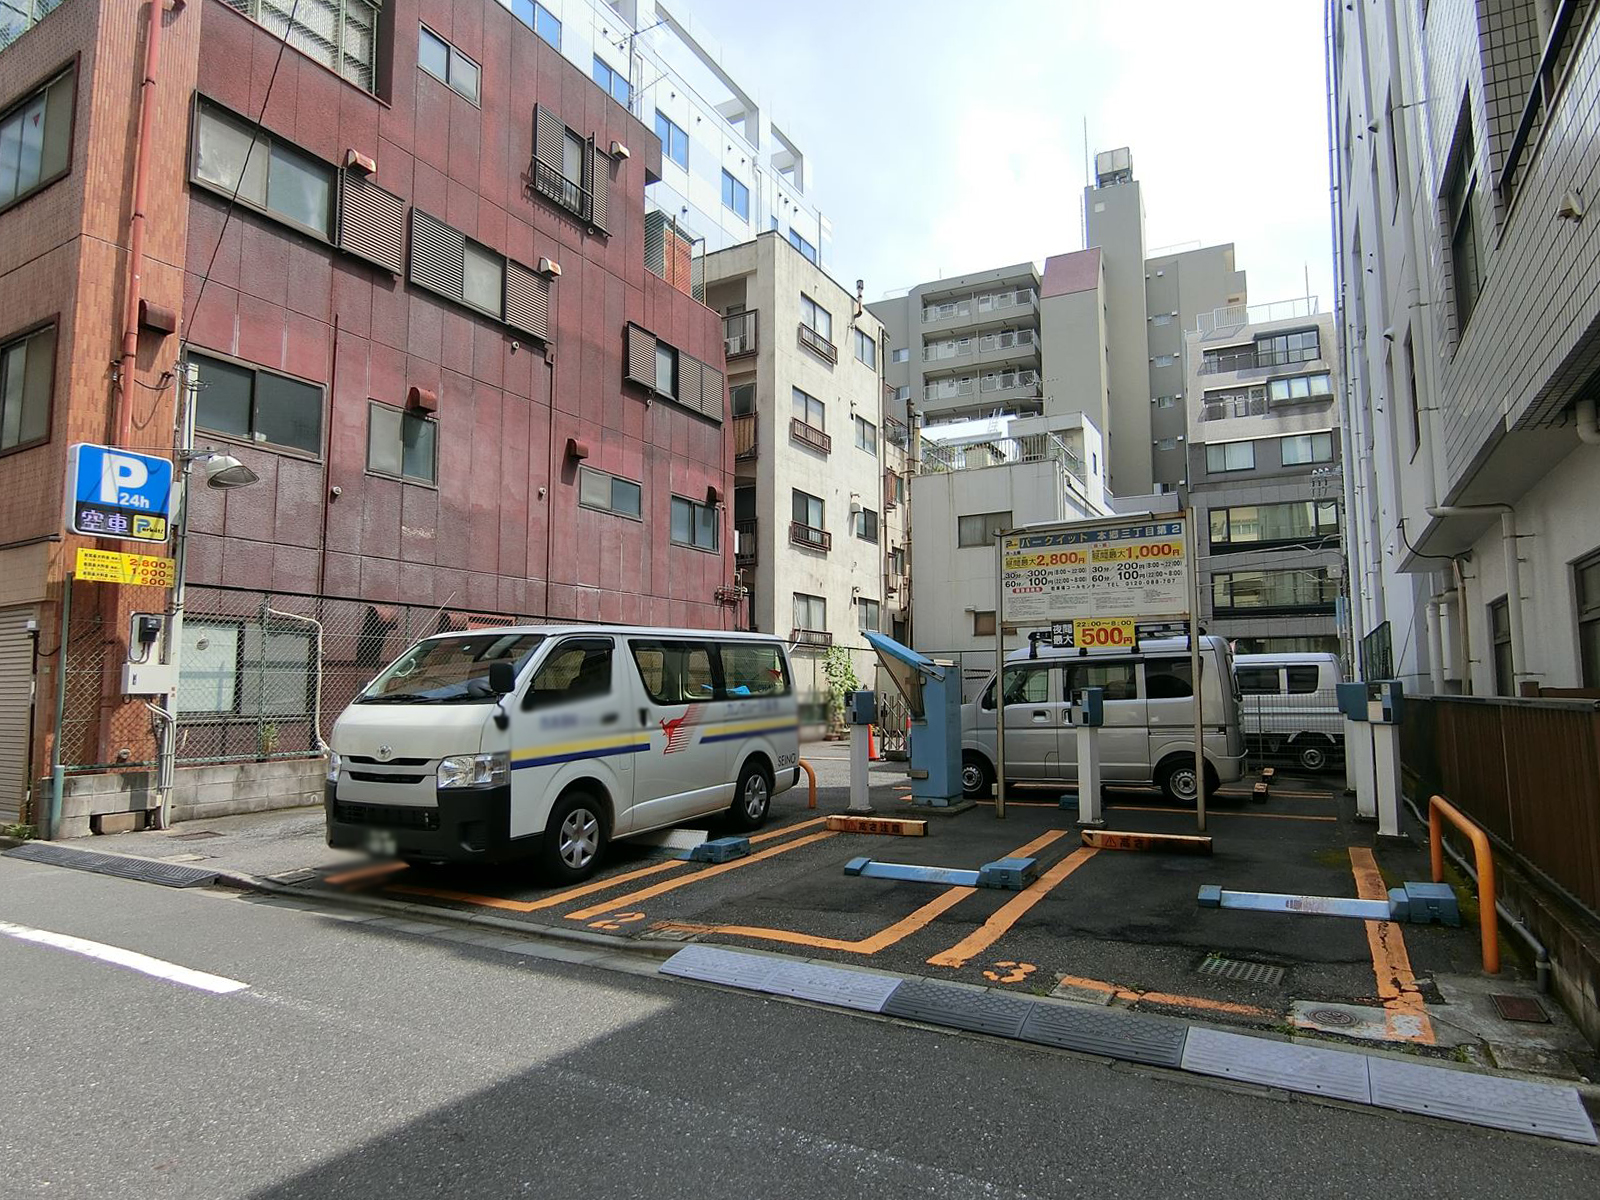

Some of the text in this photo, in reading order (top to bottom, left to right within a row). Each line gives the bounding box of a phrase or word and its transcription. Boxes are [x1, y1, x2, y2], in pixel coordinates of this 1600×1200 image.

[101, 453, 149, 503] P
[119, 492, 150, 509] 24h
[80, 510, 128, 533] 空車
[1081, 627, 1133, 645] 500円
